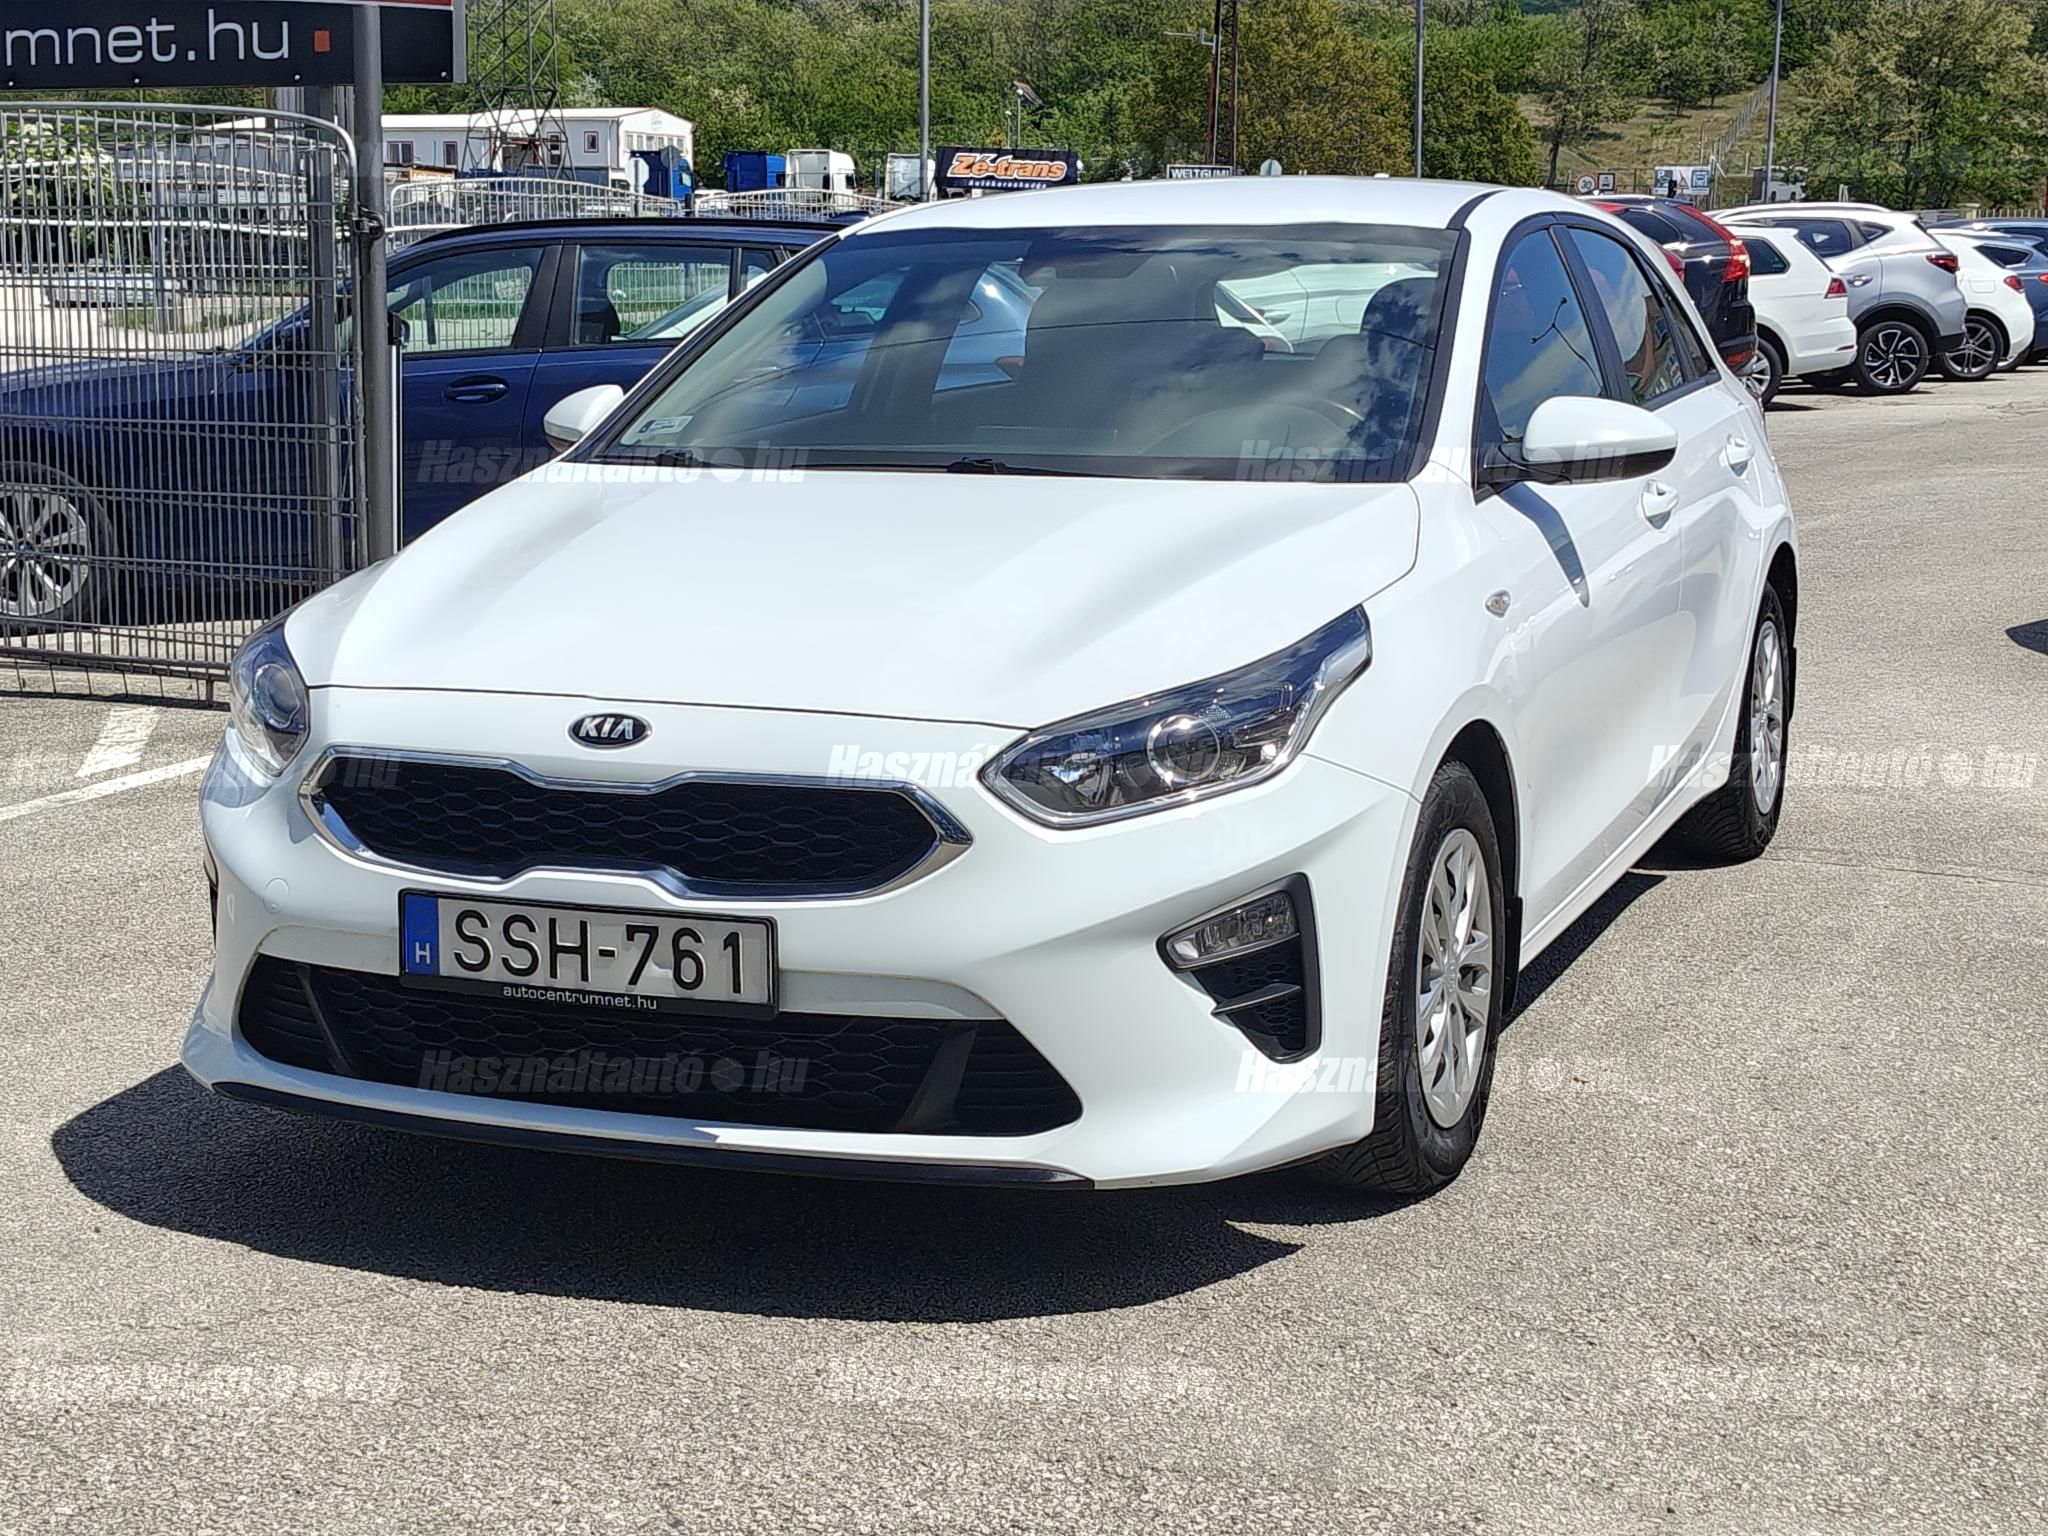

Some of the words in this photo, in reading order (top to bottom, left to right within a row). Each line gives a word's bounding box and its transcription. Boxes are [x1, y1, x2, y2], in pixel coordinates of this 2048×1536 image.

[5, 9, 290, 67] mnet.hu
[947, 153, 1068, 181] Zé-trans
[1580, 179, 1592, 190] 30
[578, 716, 635, 740] KIA
[415, 941, 431, 965] H
[453, 909, 744, 994] SSH-761
[502, 985, 658, 1010] autocentrumnet.hu
